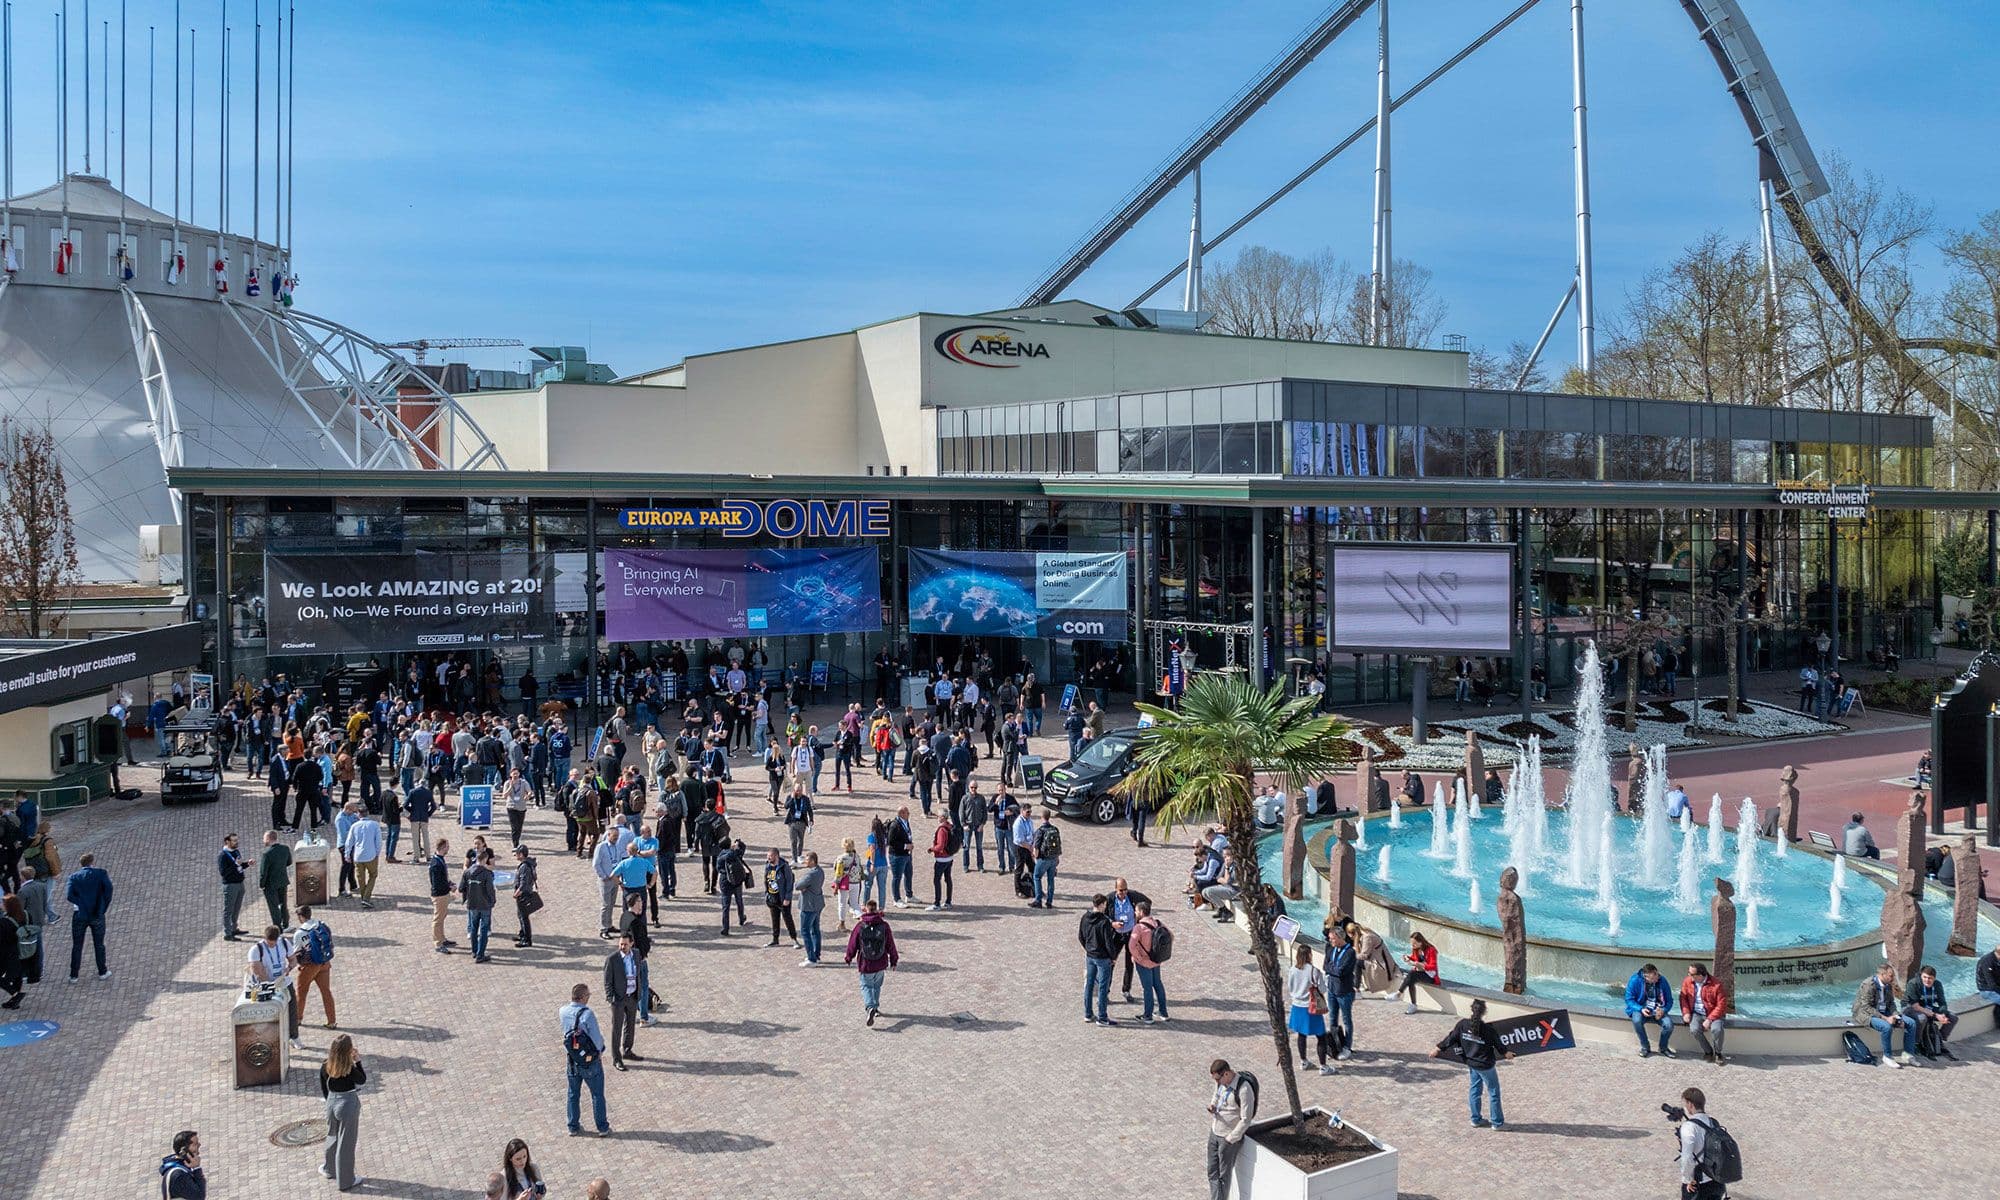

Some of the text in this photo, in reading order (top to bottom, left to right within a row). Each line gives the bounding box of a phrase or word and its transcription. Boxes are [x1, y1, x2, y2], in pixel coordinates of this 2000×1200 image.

[969, 339, 1051, 358] ARENA
[1780, 492, 1869, 504] CONFERTAINMENT
[628, 499, 891, 538] EUROPA PARK DOME
[1828, 507, 1866, 518] CENTER
[623, 566, 699, 583] Bringing AI
[1056, 570, 1079, 578] Doing
[281, 578, 543, 598] We Look AMAZING at 20!
[623, 583, 704, 599] Everywhere
[297, 606, 329, 621] (Oh,
[394, 604, 439, 617] Found
[443, 606, 451, 615] a
[456, 603, 488, 617] Grey
[492, 602, 529, 616] Hair!)
[1055, 621, 1104, 634] .com
[418, 634, 463, 645] CLOUDFEST
[9, 672, 35, 690] email
[36, 667, 58, 684] suite
[58, 665, 71, 678] for
[71, 662, 92, 679] your
[93, 651, 137, 670] customers
[1734, 957, 1848, 974] runnen der Begegnung
